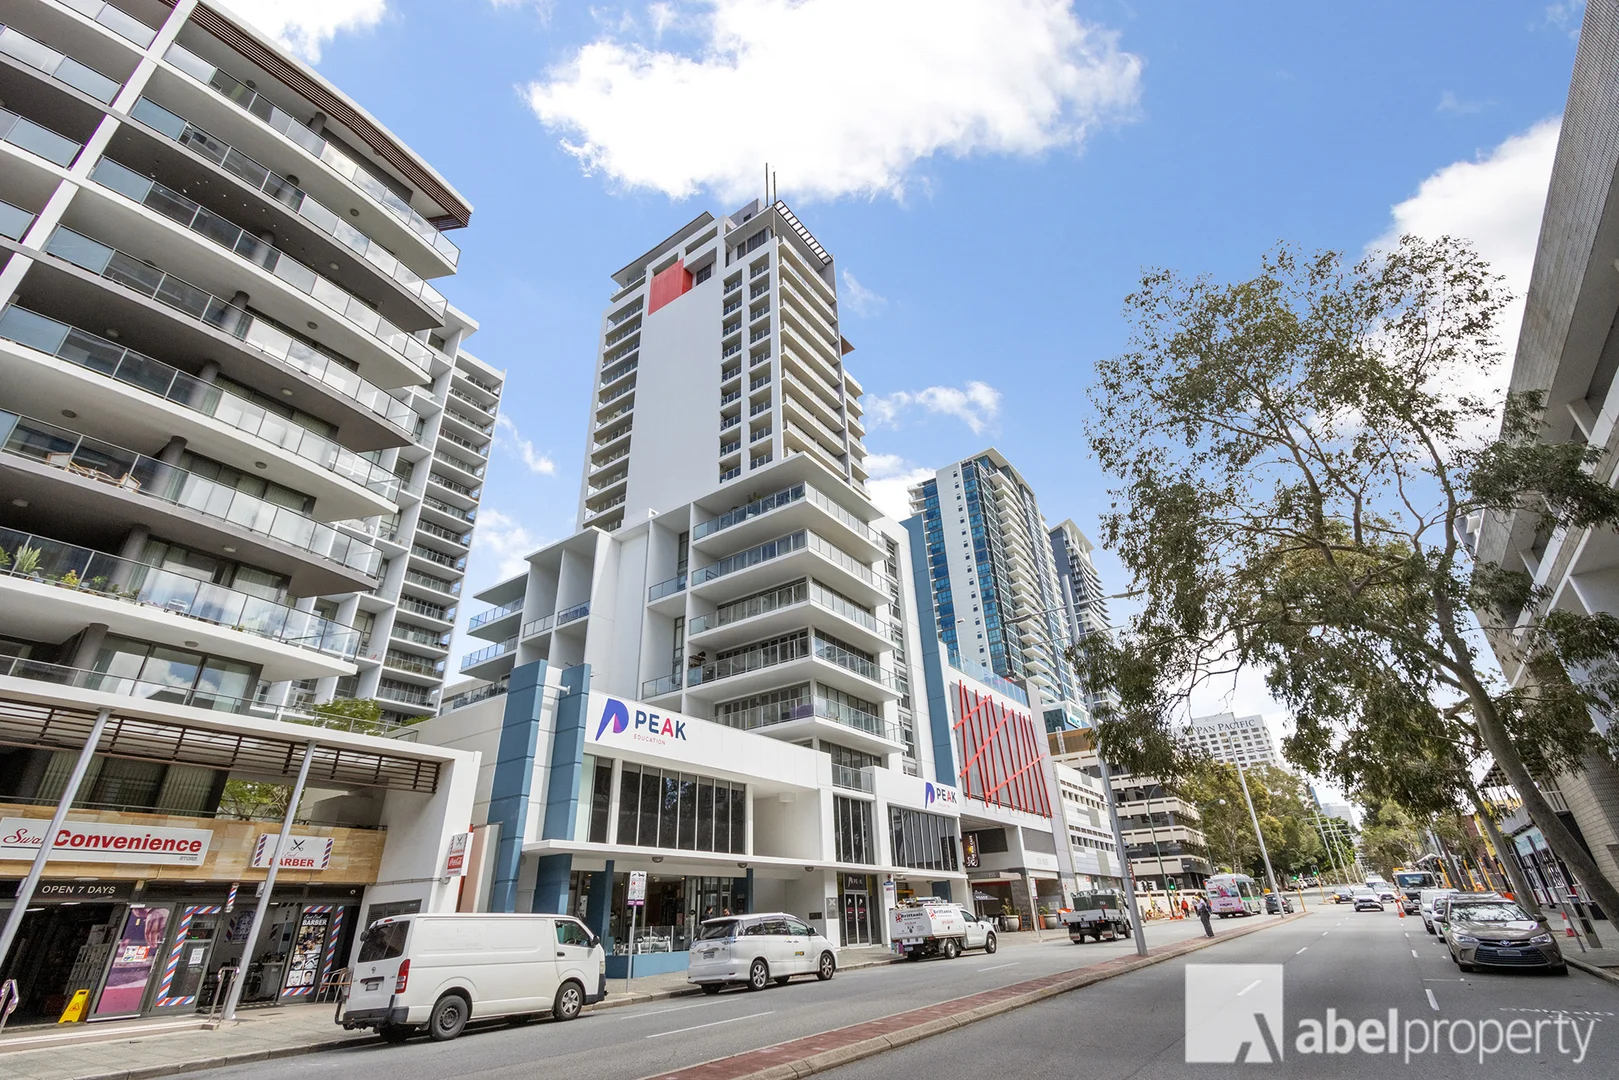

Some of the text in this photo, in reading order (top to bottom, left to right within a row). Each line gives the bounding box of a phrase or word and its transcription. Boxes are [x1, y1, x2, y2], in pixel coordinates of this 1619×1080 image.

[635, 710, 686, 741] PEAK
[1197, 719, 1256, 734] PAN PACIFIC
[634, 733, 666, 745] EDUCATION
[936, 787, 958, 804] PEAK
[53, 829, 202, 853] Convenience
[41, 885, 116, 894] OPEN 7 DAYS
